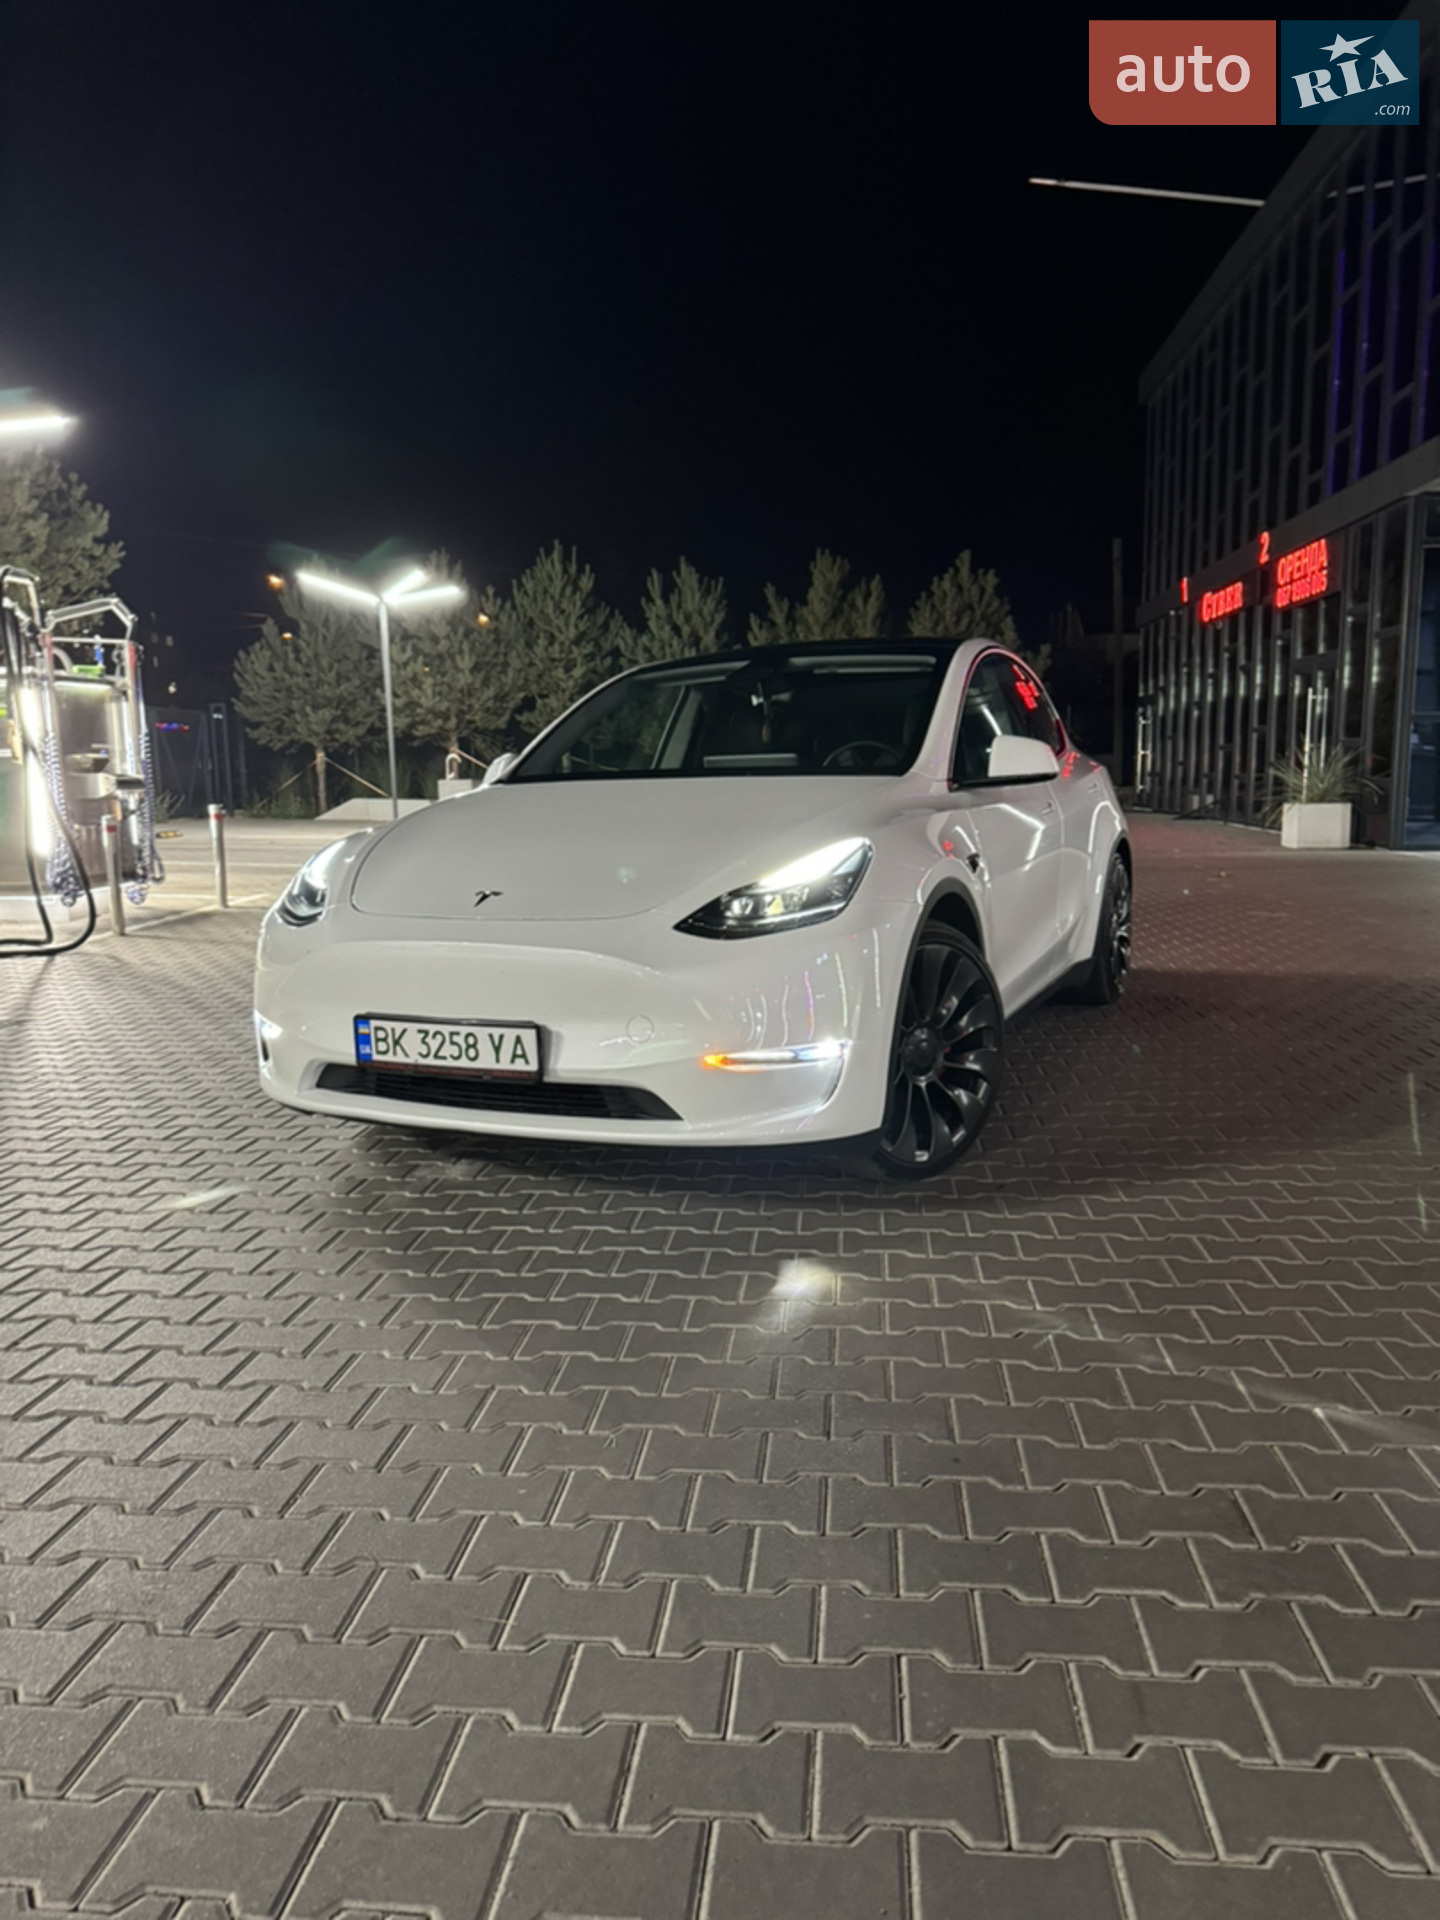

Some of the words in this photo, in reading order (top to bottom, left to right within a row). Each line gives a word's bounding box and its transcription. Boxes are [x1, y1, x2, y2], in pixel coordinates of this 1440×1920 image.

[1259, 531, 1270, 564] 2
[1277, 538, 1328, 586] ОРЕНДА
[1181, 576, 1189, 603] 1
[373, 1026, 410, 1058] BK
[416, 1029, 480, 1062] 3258
[488, 1033, 530, 1066] YA
